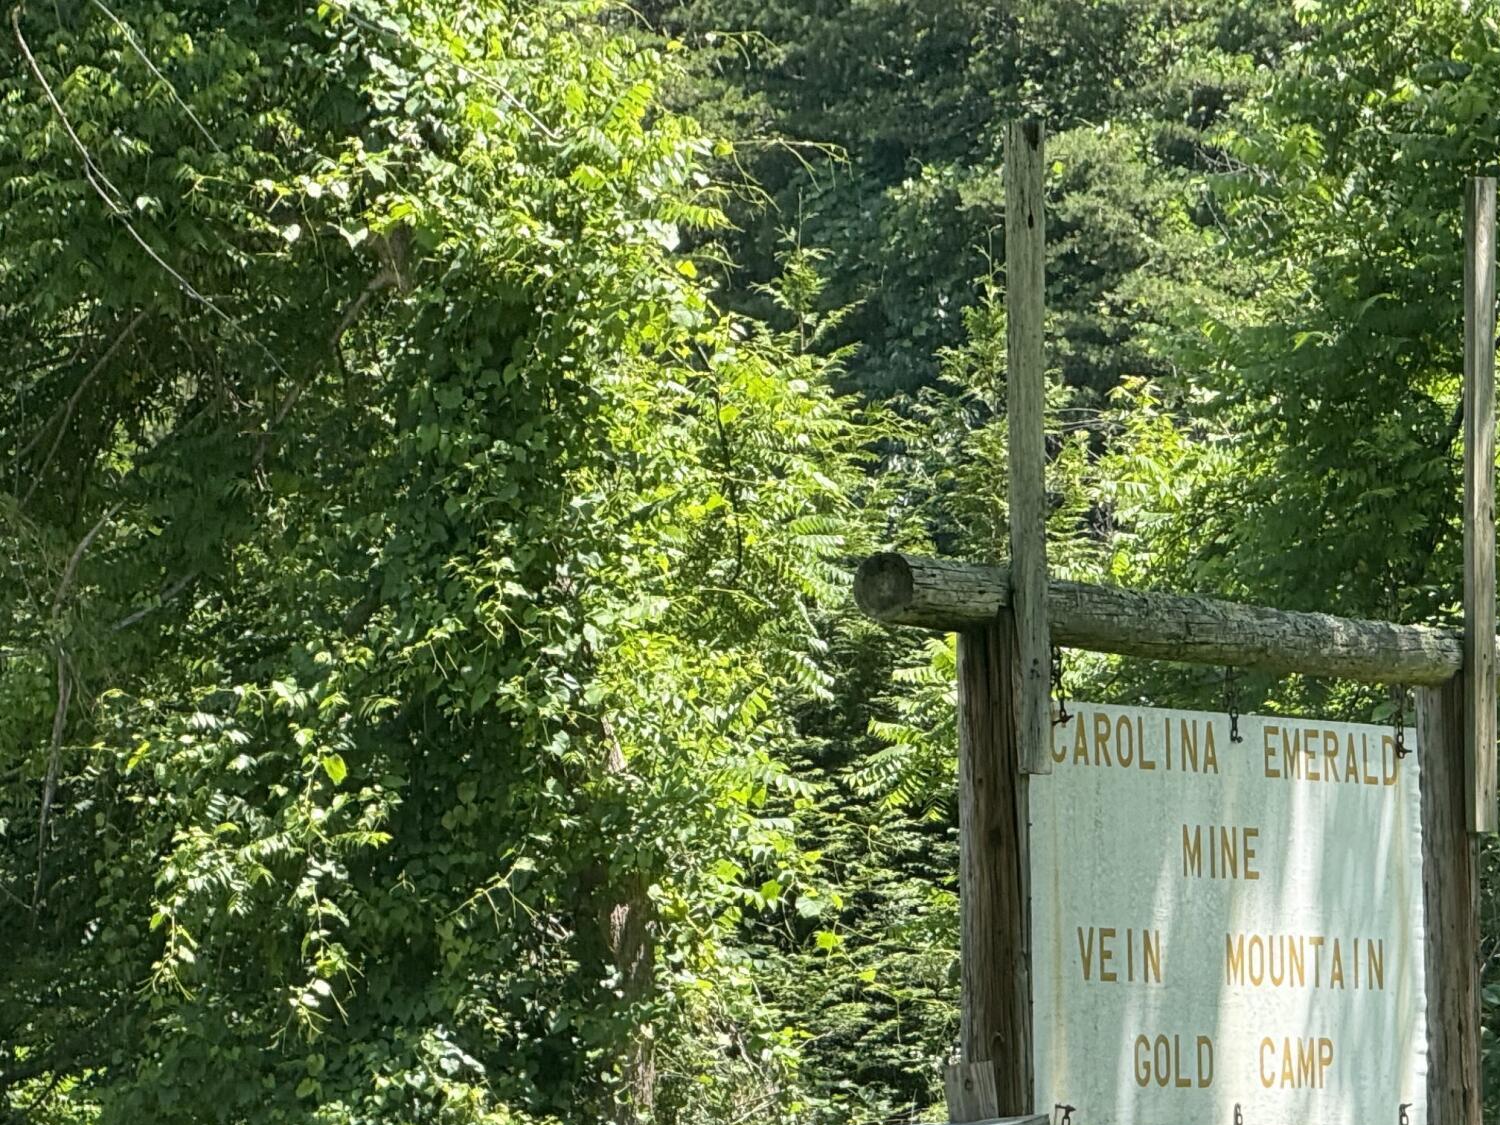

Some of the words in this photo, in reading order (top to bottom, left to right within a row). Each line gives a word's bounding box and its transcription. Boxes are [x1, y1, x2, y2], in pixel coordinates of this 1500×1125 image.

[1050, 711, 1219, 774] CAROLINA
[1264, 726, 1399, 786] EMERALD
[1183, 824, 1260, 880] MINE
[1078, 926, 1161, 984] VEIN
[1226, 932, 1385, 990] MOUNTAIN
[1134, 1034, 1214, 1088] GOLD
[1259, 1036, 1334, 1089] CAMP
